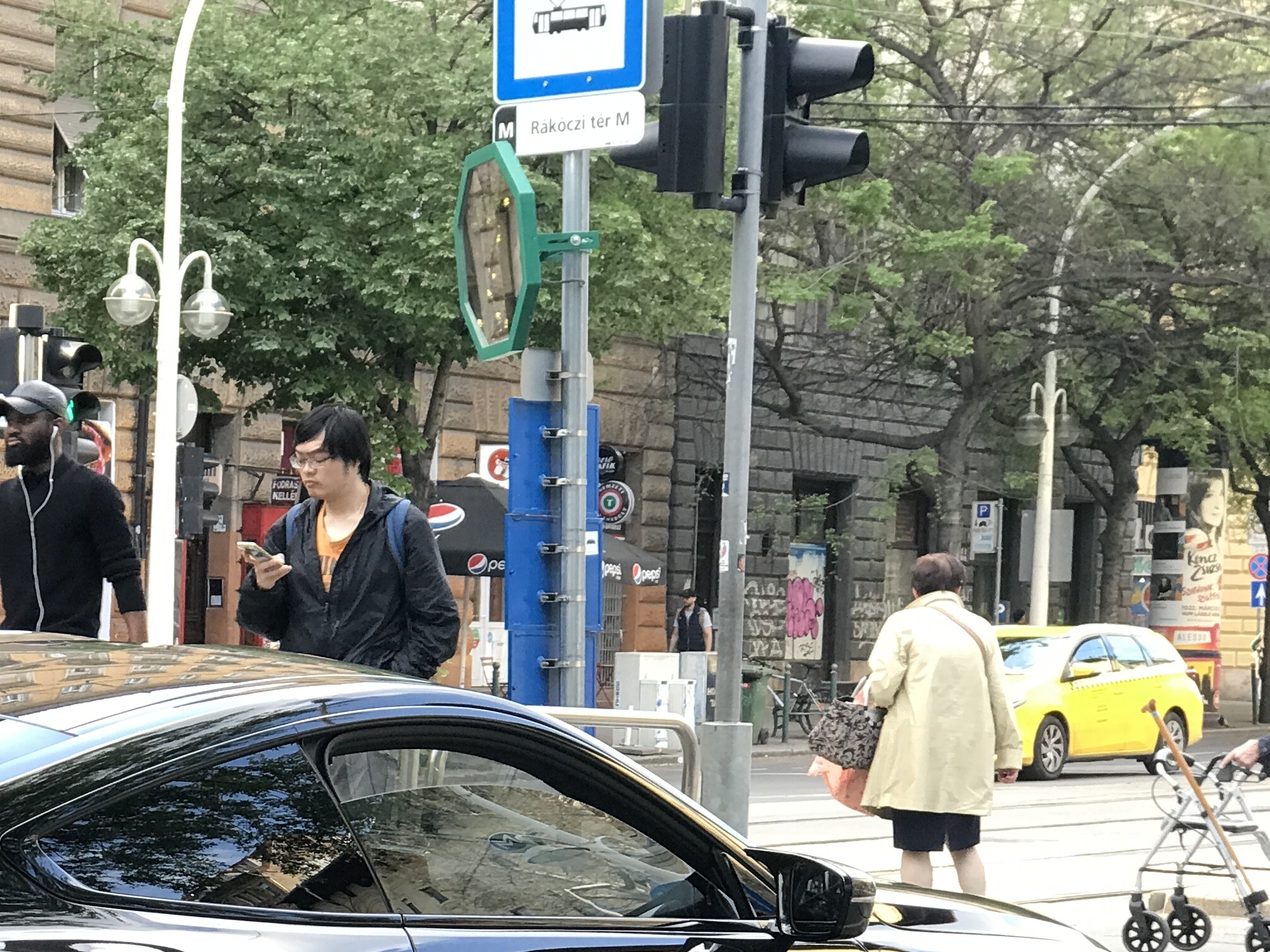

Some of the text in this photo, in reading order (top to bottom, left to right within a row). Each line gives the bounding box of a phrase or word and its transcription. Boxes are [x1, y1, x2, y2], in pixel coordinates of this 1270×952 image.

[531, 111, 630, 135] Rákóczi tér M
[641, 566, 661, 583] pepsi
